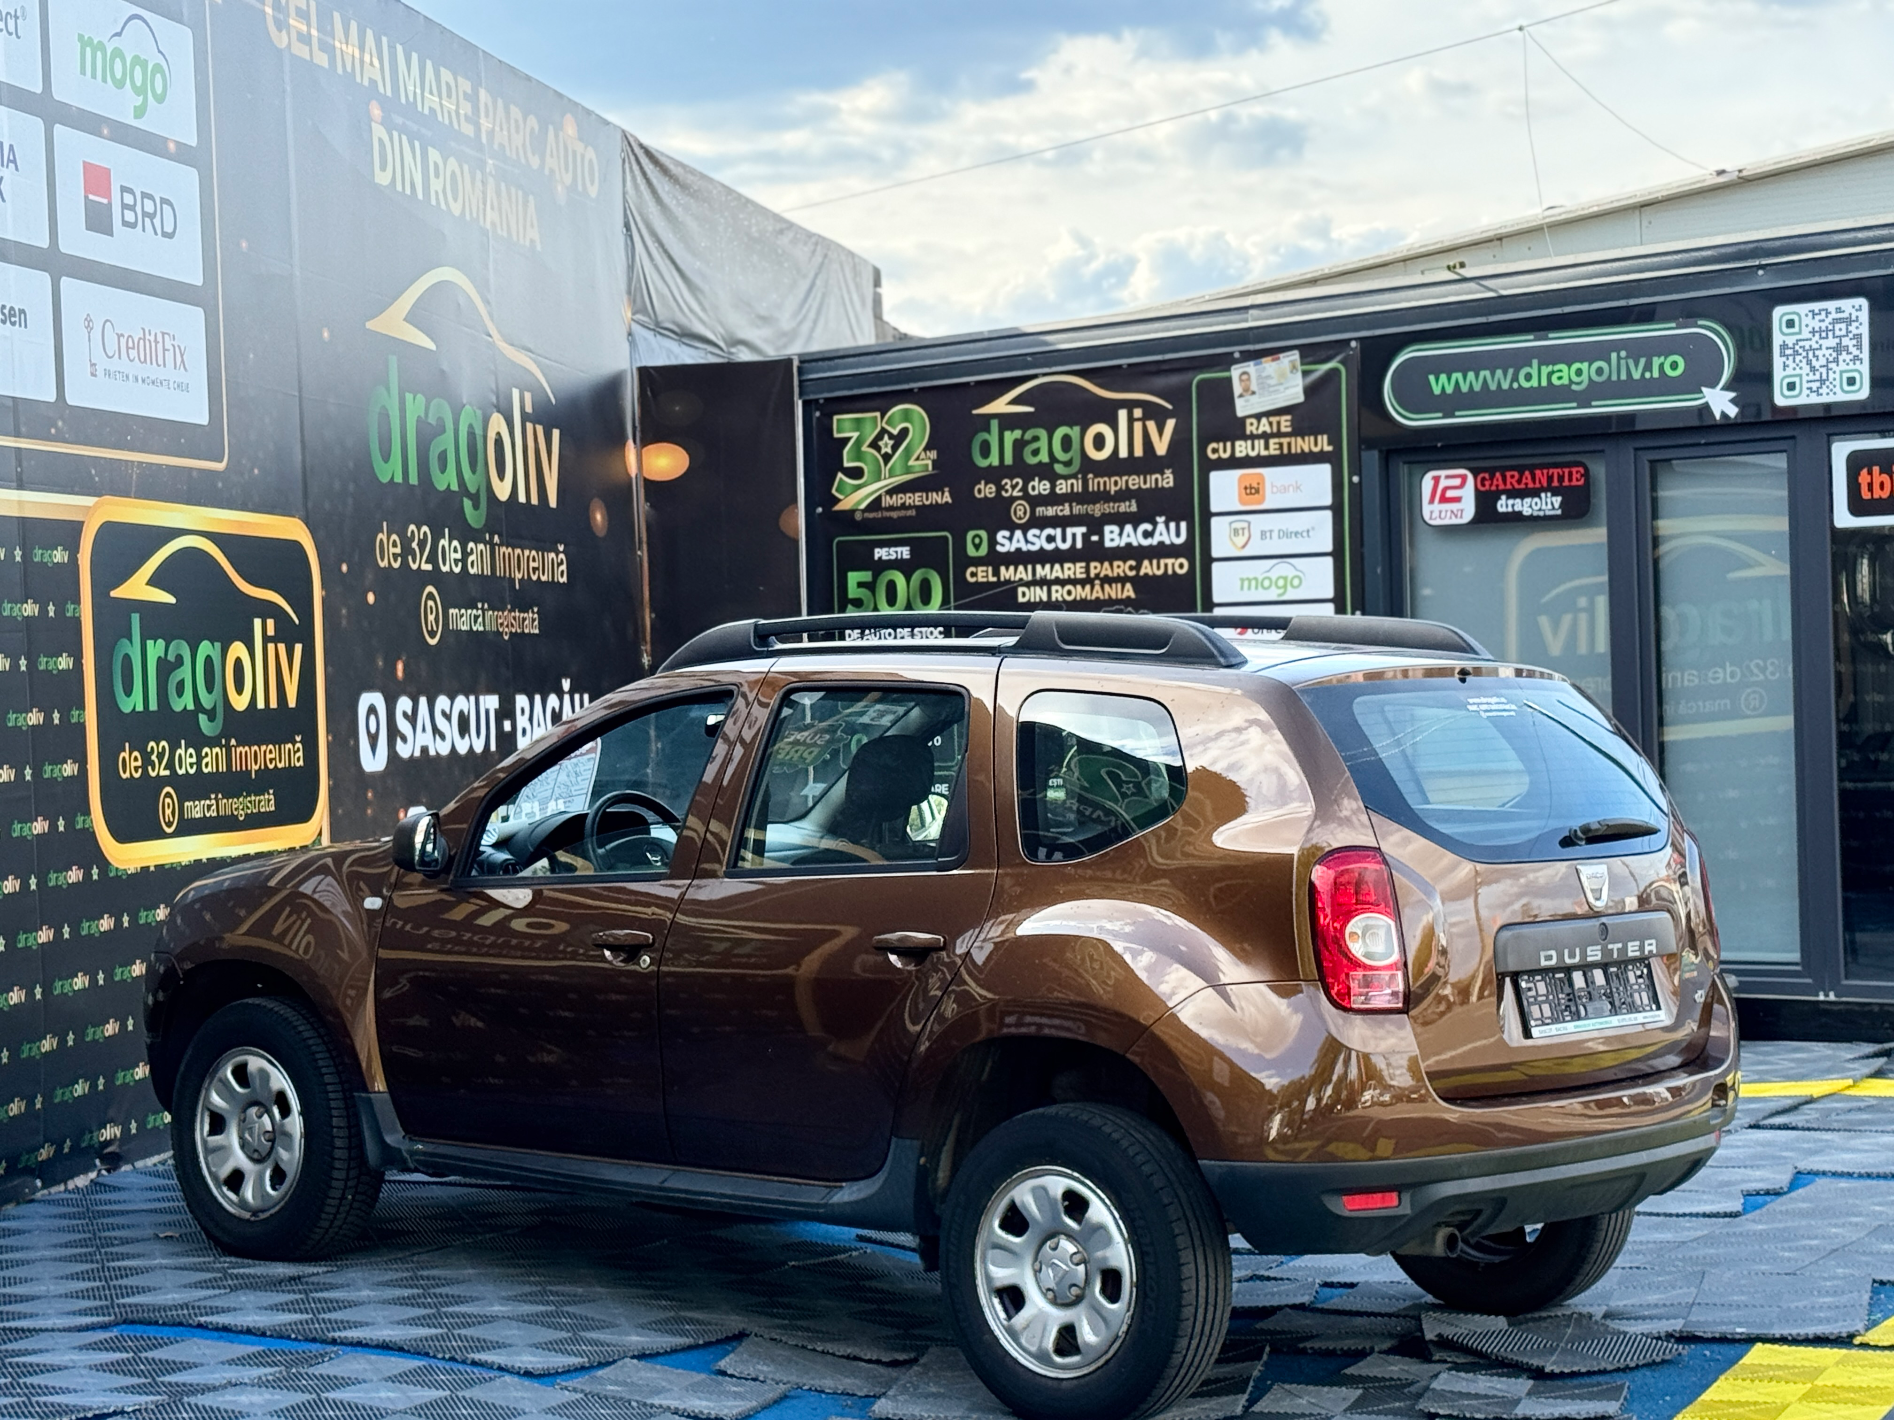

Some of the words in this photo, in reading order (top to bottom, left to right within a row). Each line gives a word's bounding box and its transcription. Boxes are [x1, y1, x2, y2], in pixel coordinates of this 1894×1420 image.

[77, 33, 168, 120] mogo
[264, 0, 329, 69] CEL
[333, 11, 393, 97] MAI
[395, 42, 475, 138] MARE
[478, 87, 541, 171] PARC
[544, 123, 600, 199] AUTO
[371, 121, 424, 201] DIN
[428, 146, 541, 252] ROMÂNIA
[119, 184, 178, 240] BRD
[101, 318, 189, 373] CreditFix
[1428, 350, 1686, 396] www.dragoliv.ro
[1245, 414, 1292, 436] RATE
[367, 354, 560, 529] dragoliv
[831, 403, 931, 500] 32
[919, 449, 938, 461] ANI
[971, 408, 1177, 476] dragoliv
[1206, 441, 1232, 460] CU
[1234, 434, 1334, 459] BULETINUL
[974, 479, 996, 498] de
[1001, 477, 1023, 497] 32
[1028, 476, 1051, 496] de
[1055, 474, 1083, 494] ani
[1087, 468, 1174, 495] împreună
[1243, 482, 1261, 496] tbi
[1270, 480, 1303, 495] bank
[1428, 473, 1469, 505] 12
[1476, 466, 1585, 492] GARANTIE
[881, 487, 953, 508] ÎMPREUNĂ
[1035, 502, 1071, 518] marcă
[1072, 499, 1138, 517] înregistrată
[1496, 491, 1563, 516] dragoliv
[1428, 508, 1465, 521] LUNI
[995, 526, 1087, 553] SASCUT
[1103, 516, 1188, 548] BACĂU
[1232, 527, 1247, 538] BT
[1259, 529, 1274, 541] BT
[32, 545, 69, 568] dragoliv
[375, 521, 402, 569] de
[407, 523, 433, 571] 32
[438, 528, 462, 574] de
[467, 533, 491, 576] ani
[494, 534, 568, 590] împreună
[874, 546, 911, 561] PESTE
[965, 566, 998, 583] CEL
[1000, 564, 1033, 582] MAI
[1036, 562, 1087, 581] MARE
[1090, 560, 1137, 578] PARC
[1139, 557, 1189, 576] AUTO
[845, 567, 943, 614] 500
[1017, 585, 1048, 603] DIN
[1051, 580, 1136, 602] ROMÂNIA
[1239, 573, 1304, 598] mogo
[1, 599, 40, 622] dragoliv
[449, 602, 484, 632] marcă
[484, 603, 540, 640] înregistrată
[845, 629, 862, 641] DE
[863, 628, 895, 641] AUTO
[896, 627, 912, 640] PE
[913, 626, 945, 640] STOC
[37, 652, 74, 675] dragoliv
[111, 613, 303, 737] dragoliv
[6, 707, 45, 731] dragoliv
[395, 694, 499, 759] SASCUT
[42, 759, 79, 782] dragoliv
[118, 743, 143, 779] de
[147, 740, 171, 778] 32
[174, 739, 197, 776] de
[201, 739, 227, 774] ani
[229, 735, 304, 779] împreună
[184, 793, 217, 820] marcă
[217, 789, 276, 821] înregistrată
[11, 816, 50, 841] dragoliv
[47, 865, 84, 890] dragoliv
[16, 925, 55, 950] dragoliv
[80, 914, 115, 938] dragoliv
[1539, 938, 1657, 967] DUSTER
[52, 972, 90, 997] dragoliv
[113, 959, 147, 982] dragoliv
[20, 1034, 59, 1059] dragoliv
[84, 1018, 120, 1043] dragoliv
